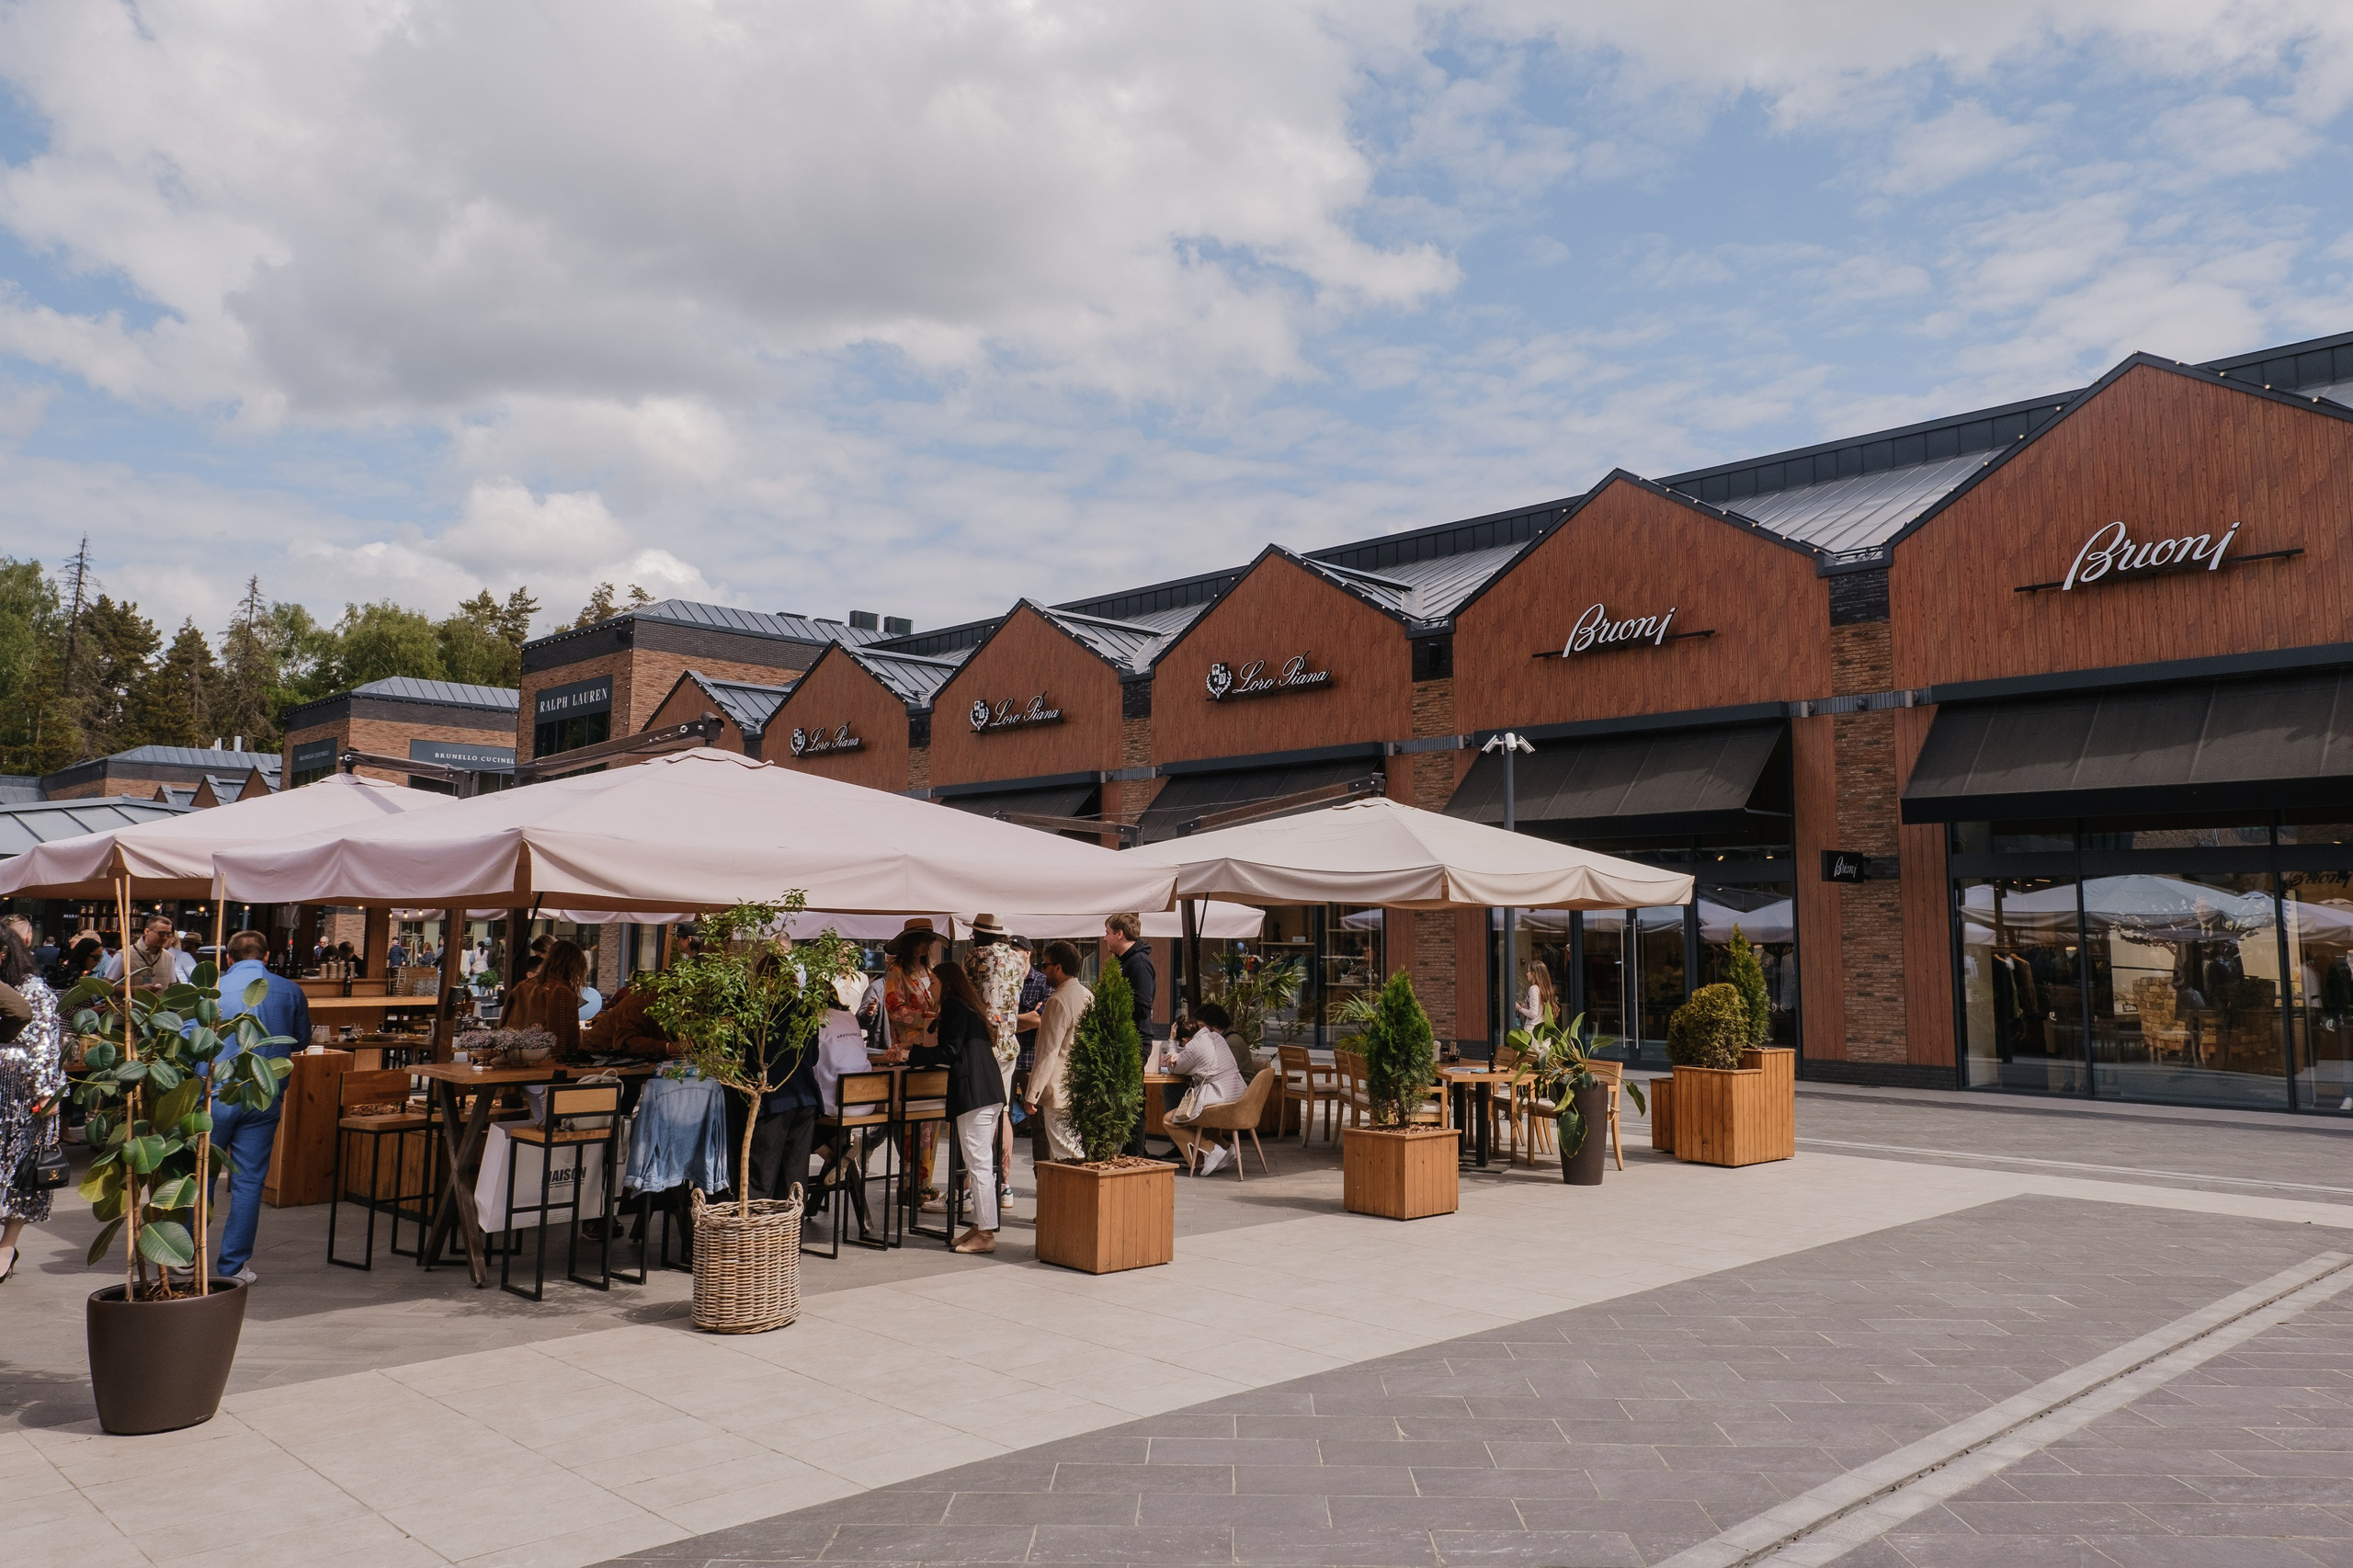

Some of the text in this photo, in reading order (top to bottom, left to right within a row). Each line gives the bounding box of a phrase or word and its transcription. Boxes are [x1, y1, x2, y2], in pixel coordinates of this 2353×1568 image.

[1232, 651, 1331, 694] Loro Piana
[540, 687, 608, 713] RALPH LAUREN
[989, 691, 1062, 727] Loro Piana
[805, 722, 861, 753] Loro Piana
[435, 752, 478, 761] BRUNELLO
